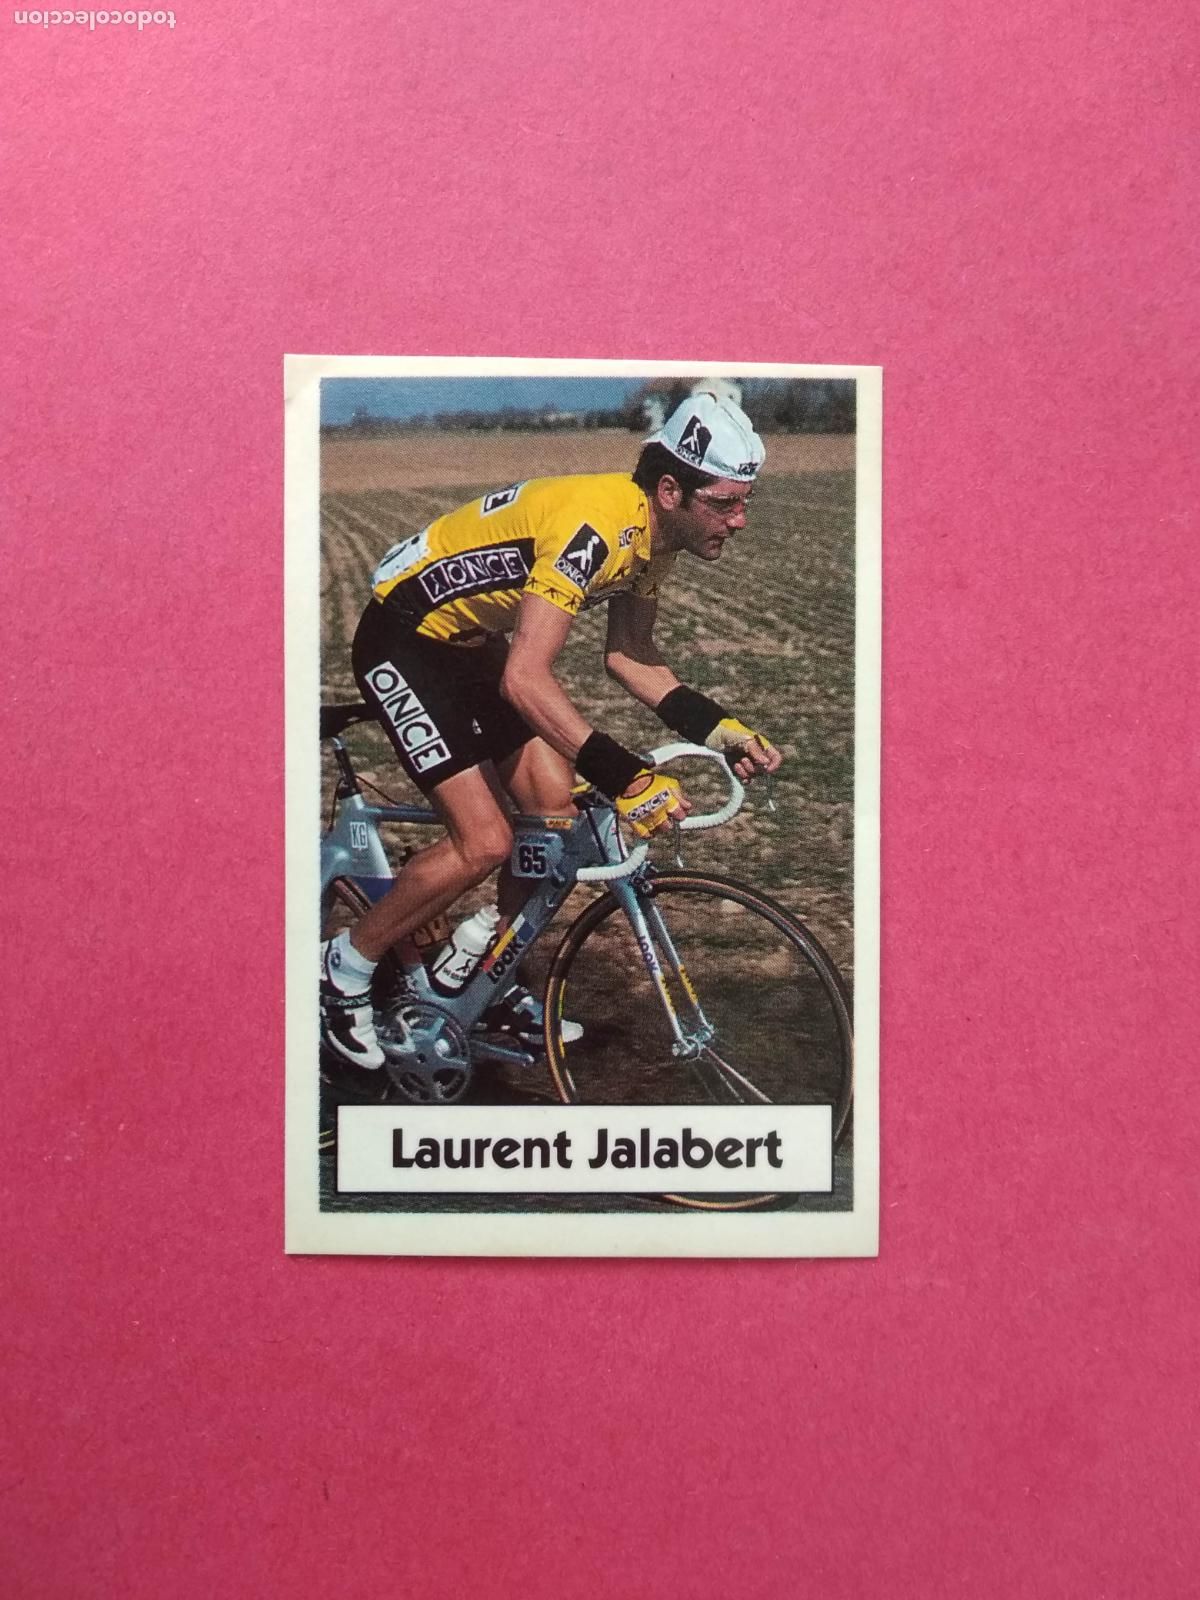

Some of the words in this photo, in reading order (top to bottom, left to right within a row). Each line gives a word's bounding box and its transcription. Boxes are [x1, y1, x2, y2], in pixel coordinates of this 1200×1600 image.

[447, 551, 524, 585] ONCE
[371, 668, 448, 770] ONCE
[351, 822, 368, 848] KG
[519, 844, 547, 875] 65
[487, 938, 526, 984] LOOK
[392, 1128, 573, 1169] Laurent
[588, 1128, 783, 1169] Jalabert
